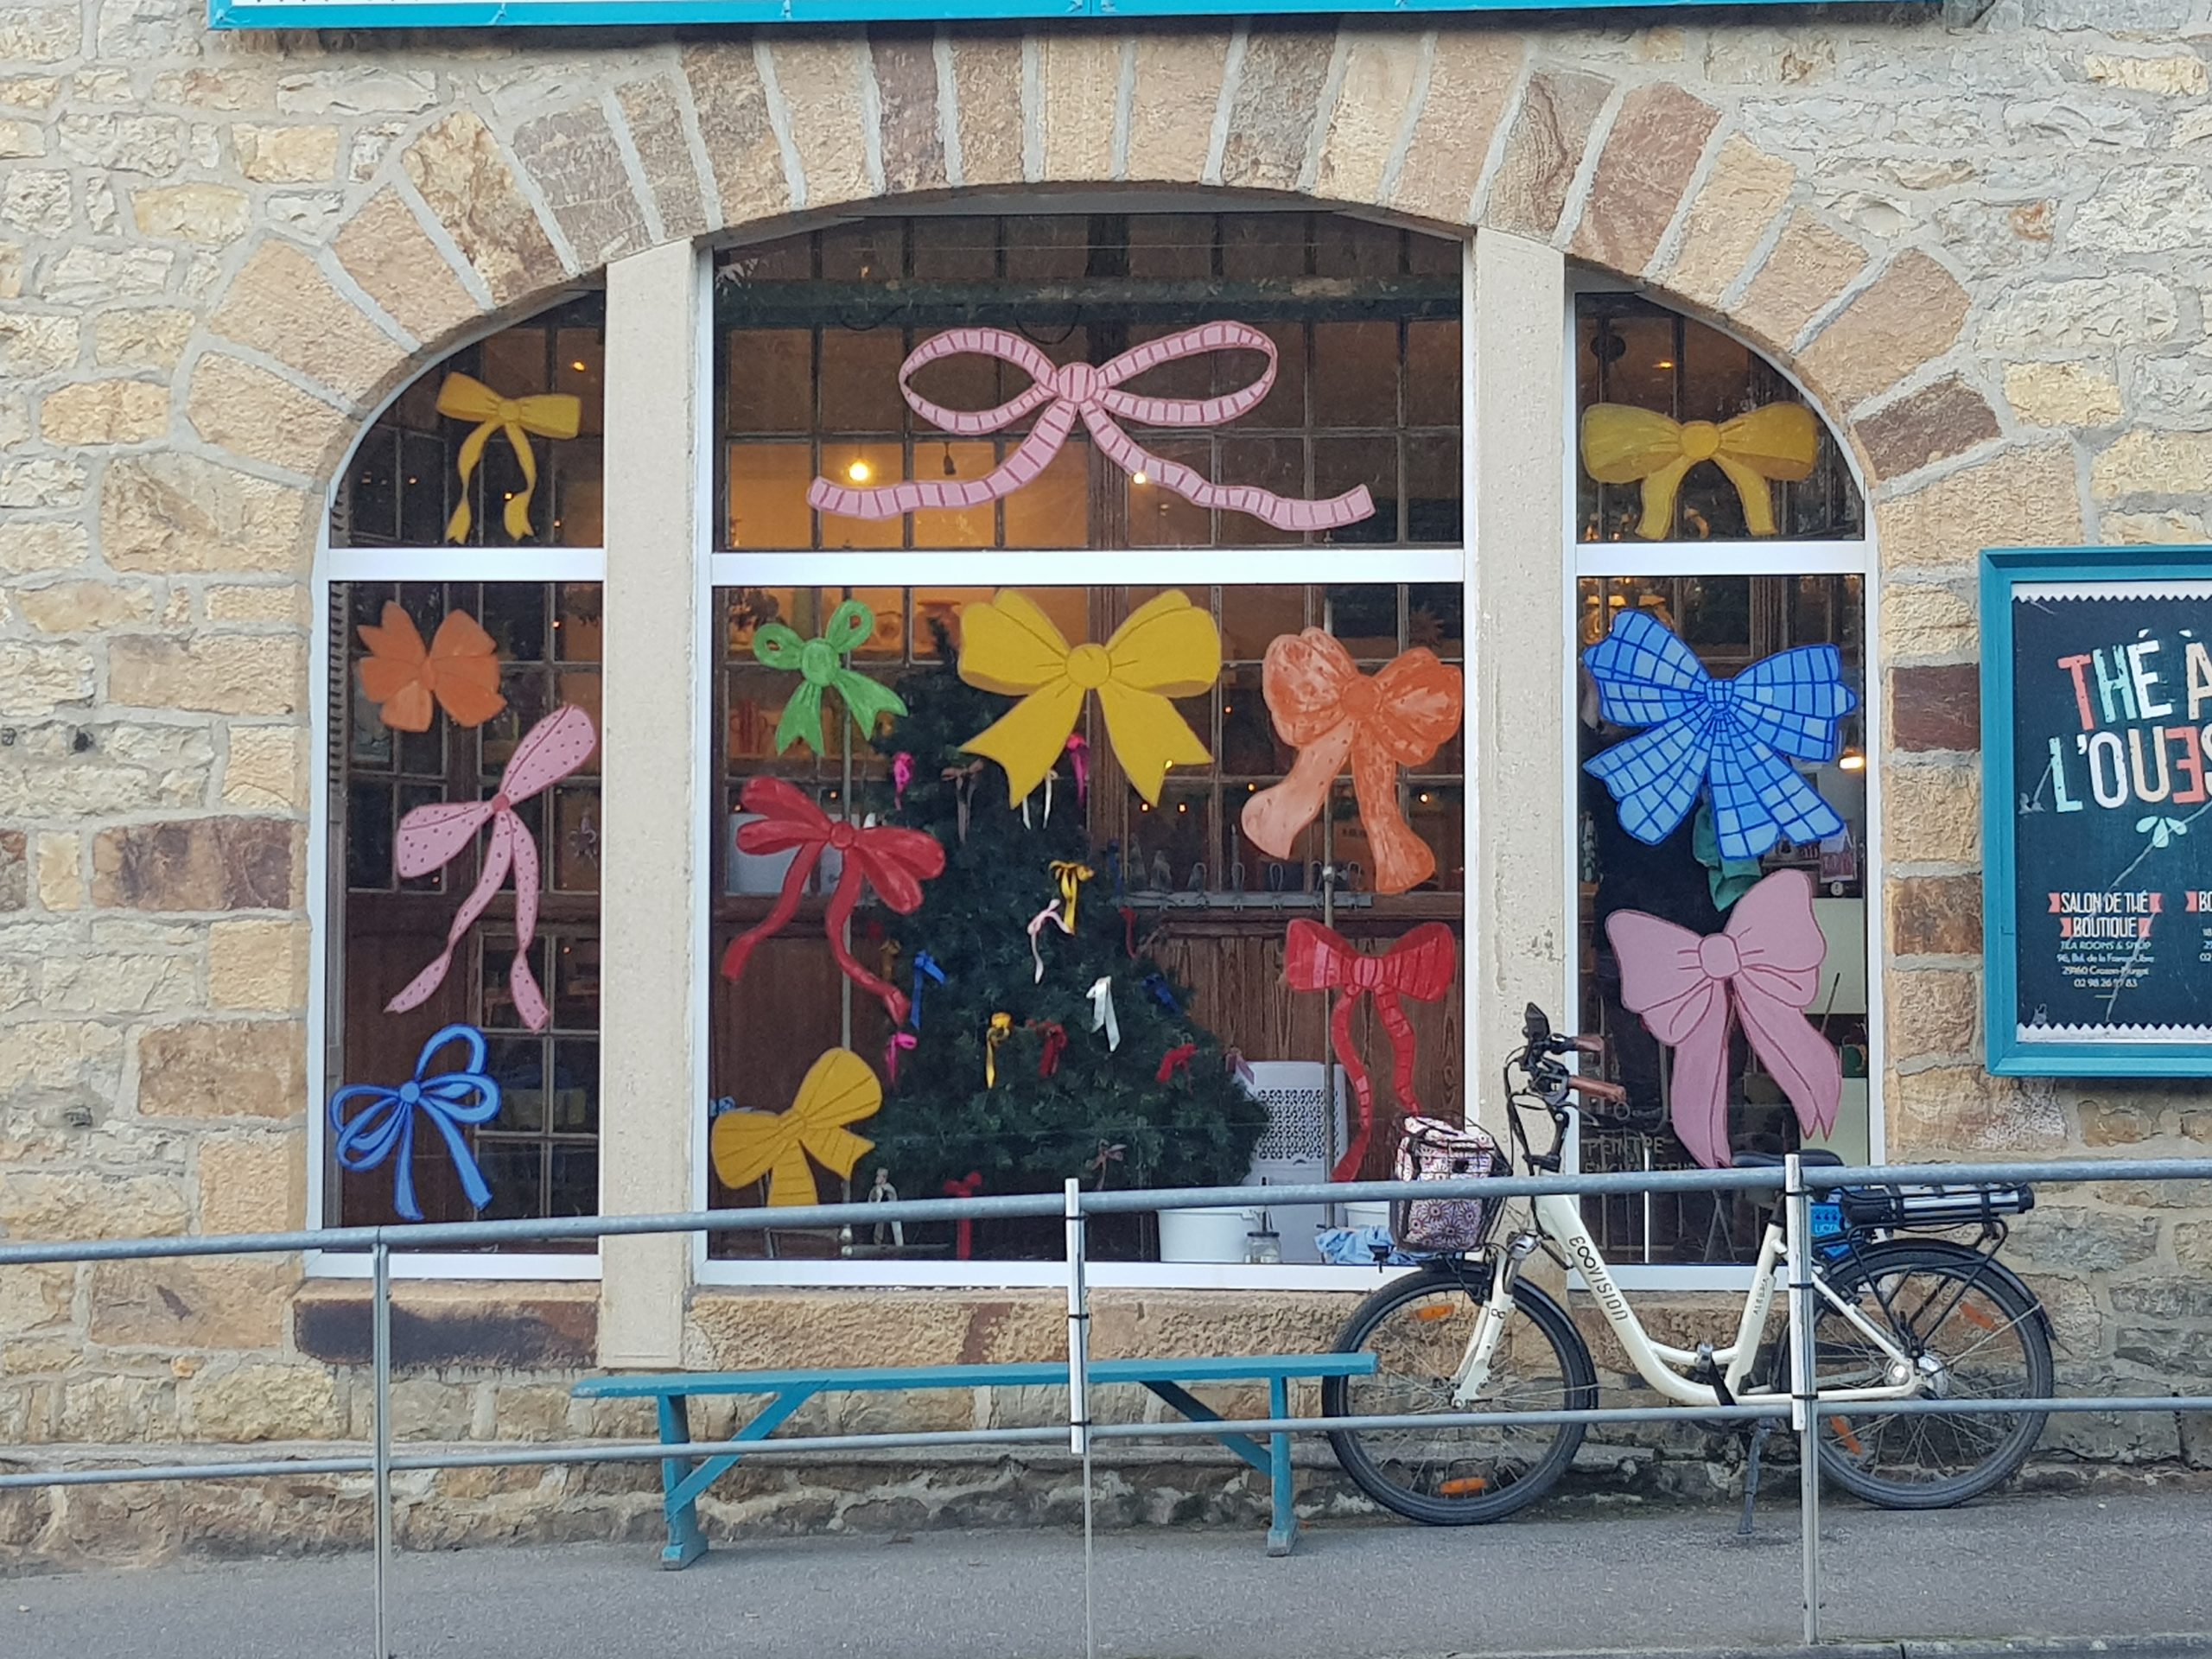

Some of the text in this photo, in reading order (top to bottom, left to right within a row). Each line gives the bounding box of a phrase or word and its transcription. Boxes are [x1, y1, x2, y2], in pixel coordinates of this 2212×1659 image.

[2057, 629, 2173, 730] THÉ
[2061, 890, 2149, 913] SALON DE THÉ
[2074, 917, 2137, 938] BOUTIQUE
